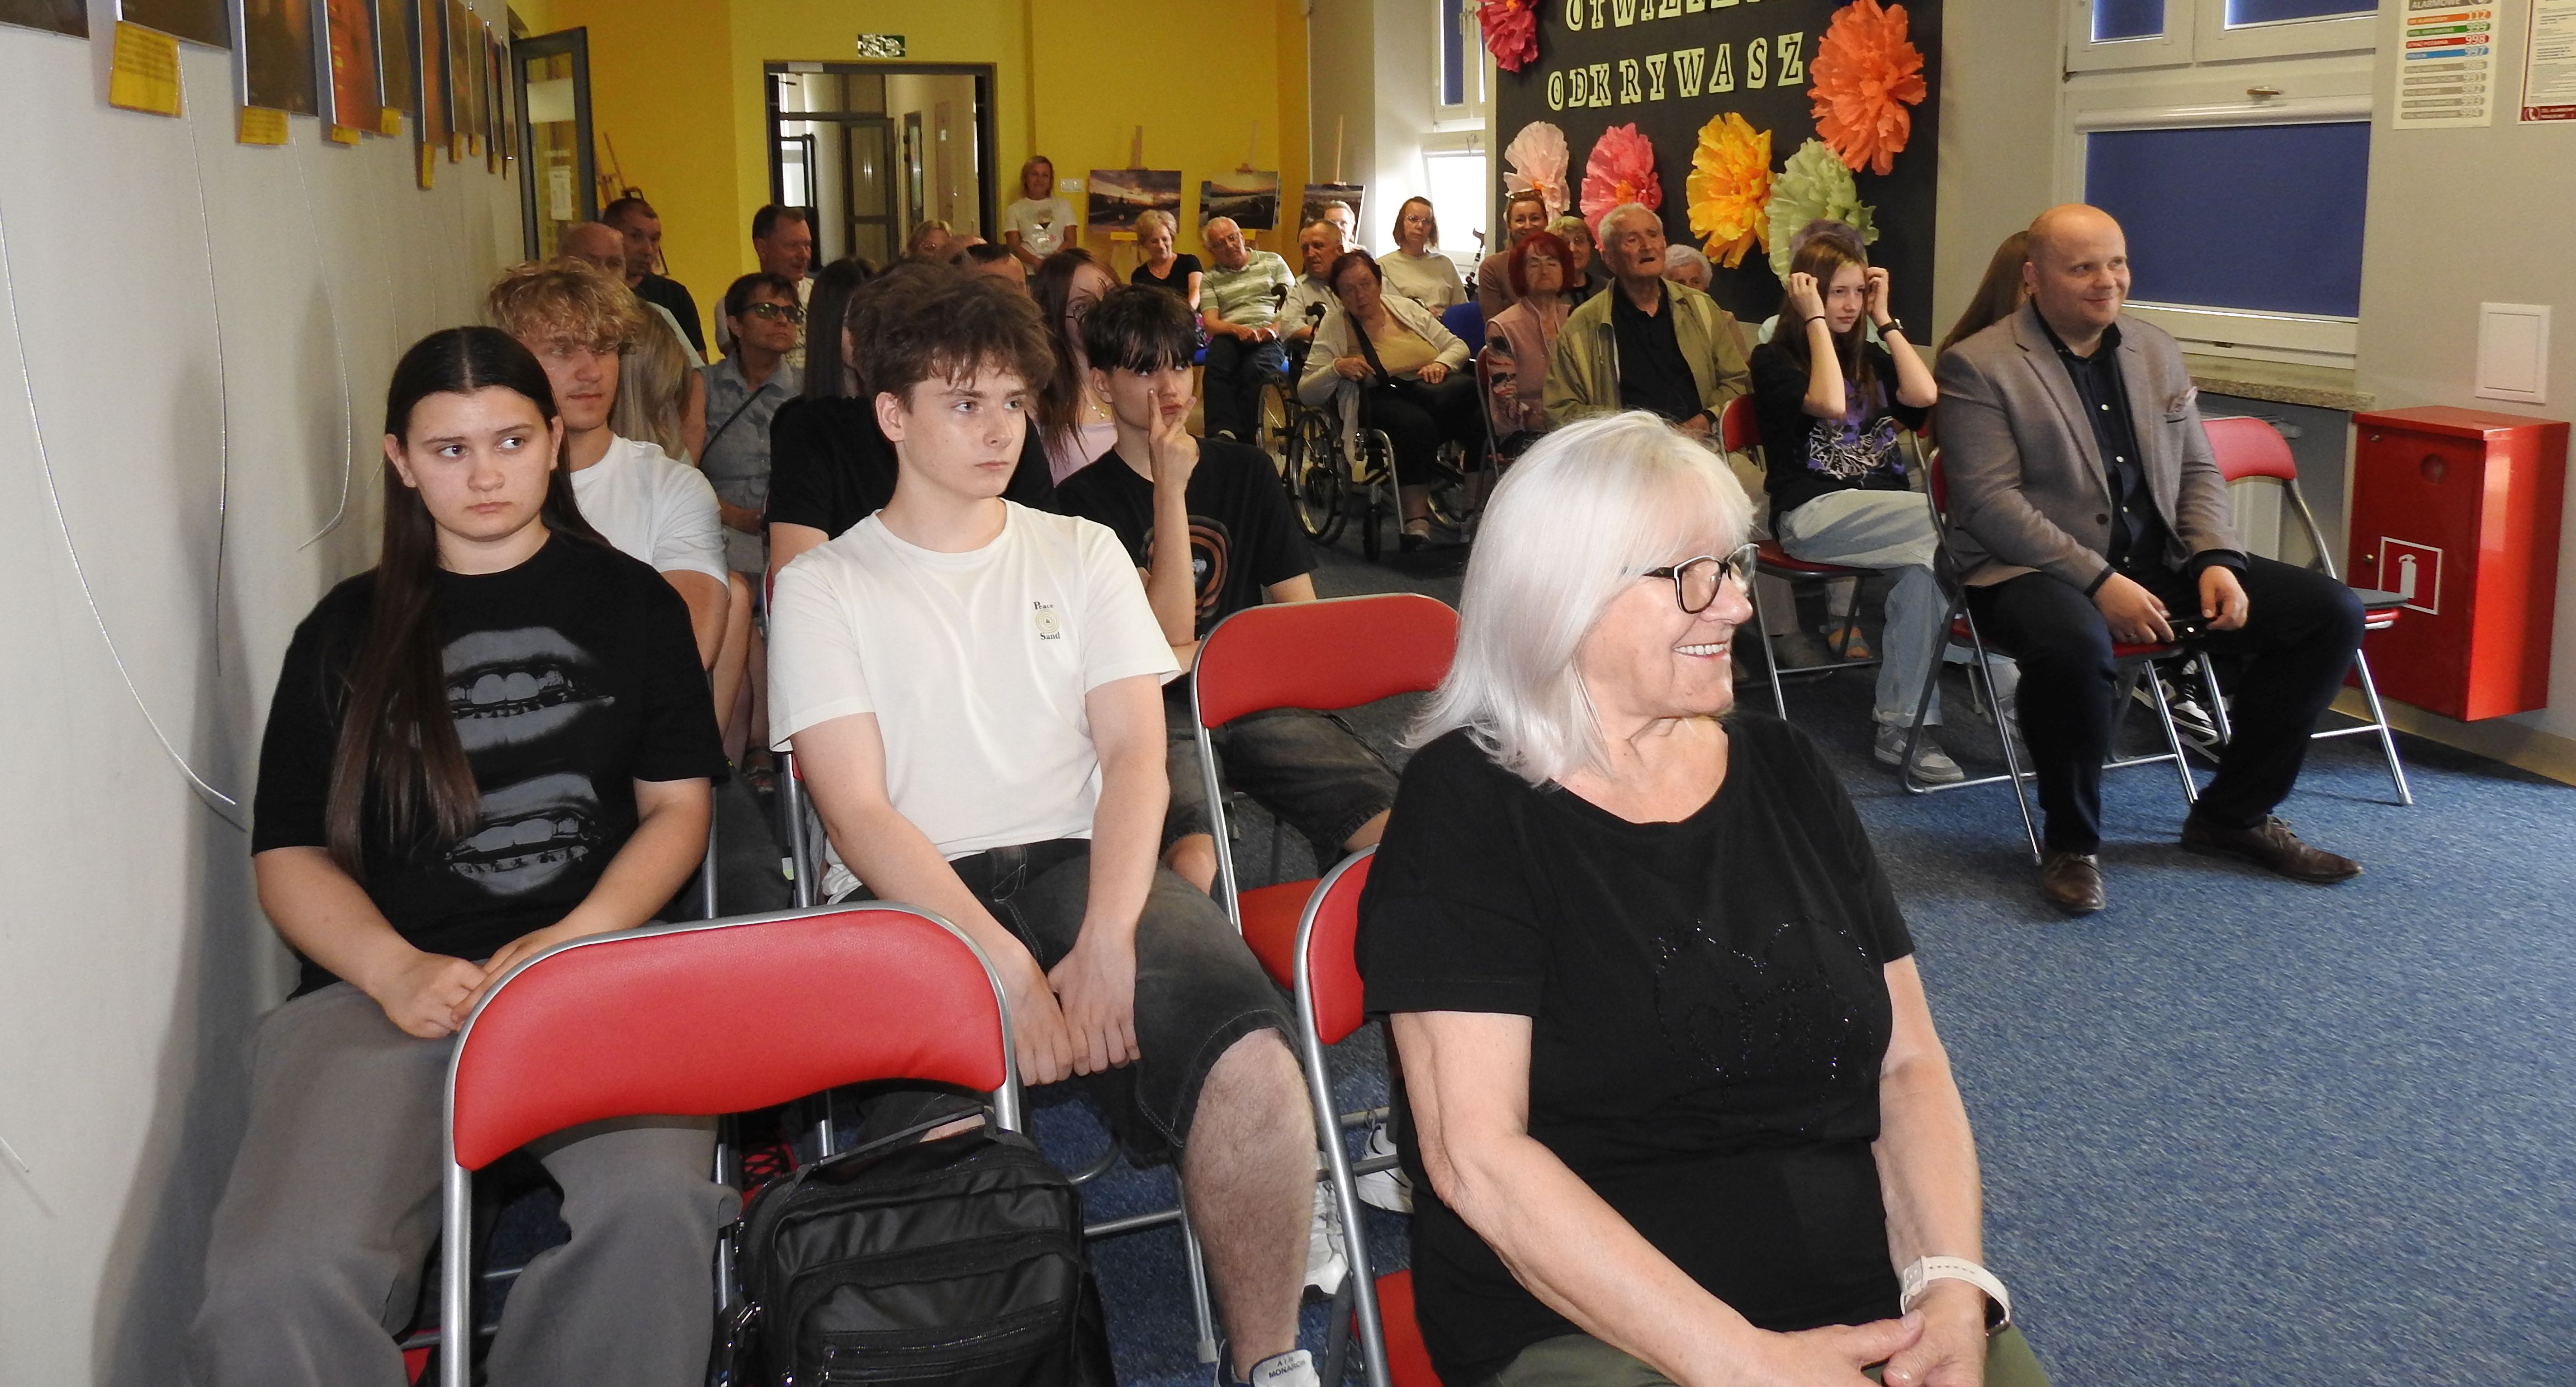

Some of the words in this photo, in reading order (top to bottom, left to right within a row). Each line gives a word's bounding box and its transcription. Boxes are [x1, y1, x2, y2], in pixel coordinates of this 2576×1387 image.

[2469, 11, 2487, 20] 112
[2467, 22, 2487, 32] 999
[2466, 35, 2485, 45] 998
[2465, 46, 2485, 56] 997
[1552, 39, 1800, 106] ODKRYWASZ
[2463, 73, 2482, 82] 991
[1033, 601, 1054, 609] Peace
[1040, 631, 1060, 640] Sand
[1268, 1358, 1306, 1378] MONARCH
